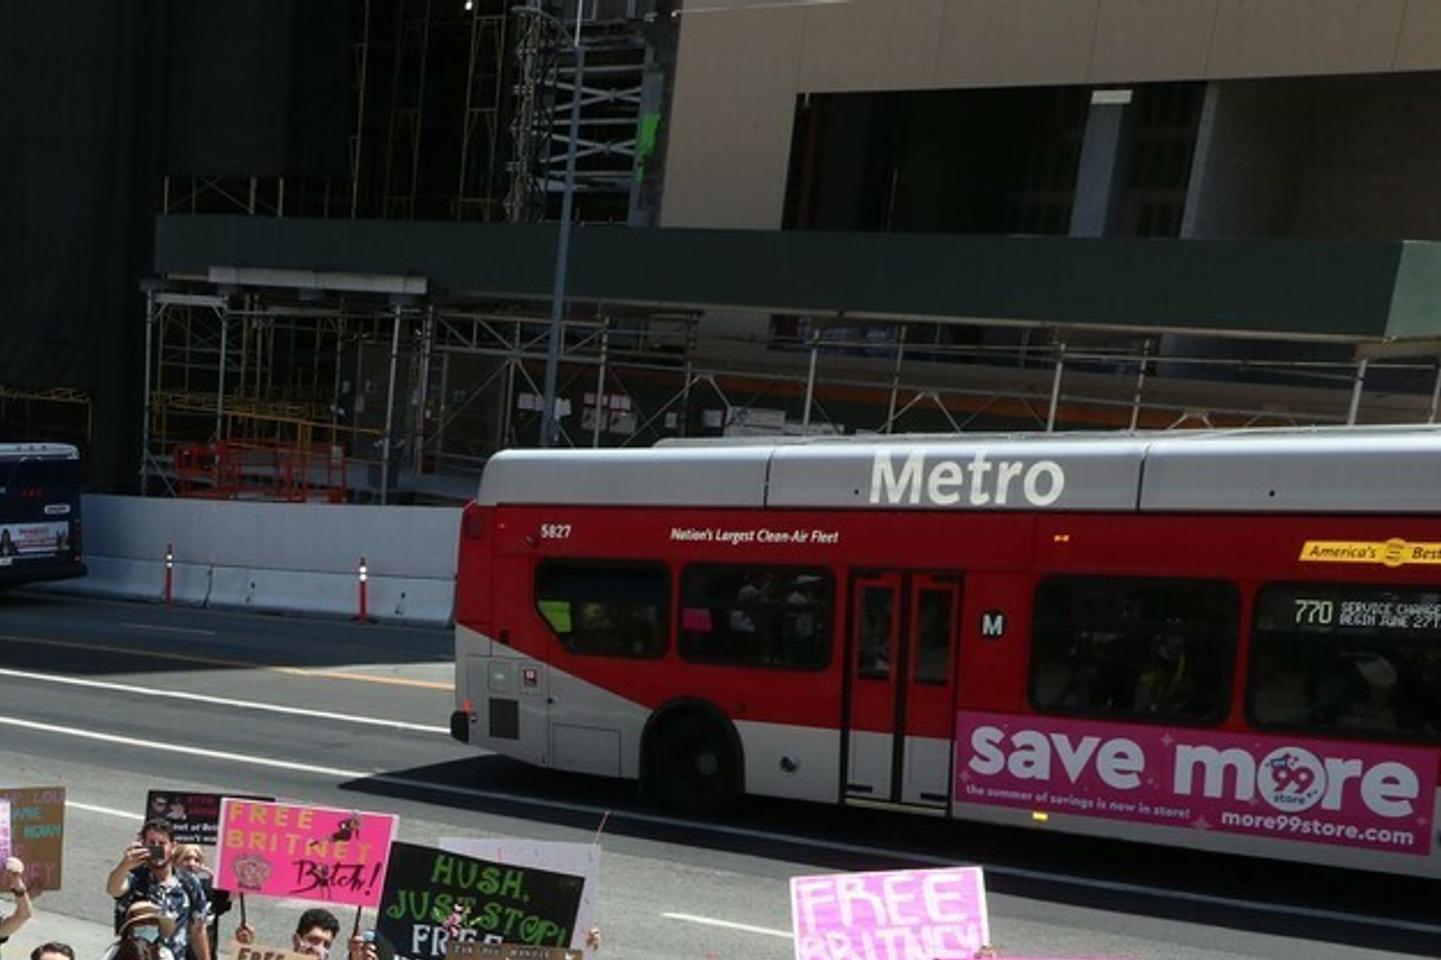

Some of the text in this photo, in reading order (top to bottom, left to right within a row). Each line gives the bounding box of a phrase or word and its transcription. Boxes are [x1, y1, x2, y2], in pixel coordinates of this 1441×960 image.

[868, 450, 1065, 506] Metro
[541, 524, 571, 538] 5827
[671, 528, 839, 544] Nation's Largest Clean-Air Fleet
[1310, 545, 1376, 559] America's
[1295, 599, 1333, 624] 770
[1341, 601, 1394, 615] SERVICE
[982, 616, 1003, 636] M
[968, 725, 1146, 791] save
[966, 784, 985, 796] the
[987, 788, 1033, 801] summer
[1035, 792, 1048, 803] of
[1050, 794, 1094, 810] savings
[1096, 798, 1106, 810] is
[1139, 803, 1151, 815] in
[229, 803, 314, 829] FREE
[1221, 810, 1415, 846] more99store.com
[226, 829, 372, 864] BRITNEY
[798, 872, 968, 934] FREE
